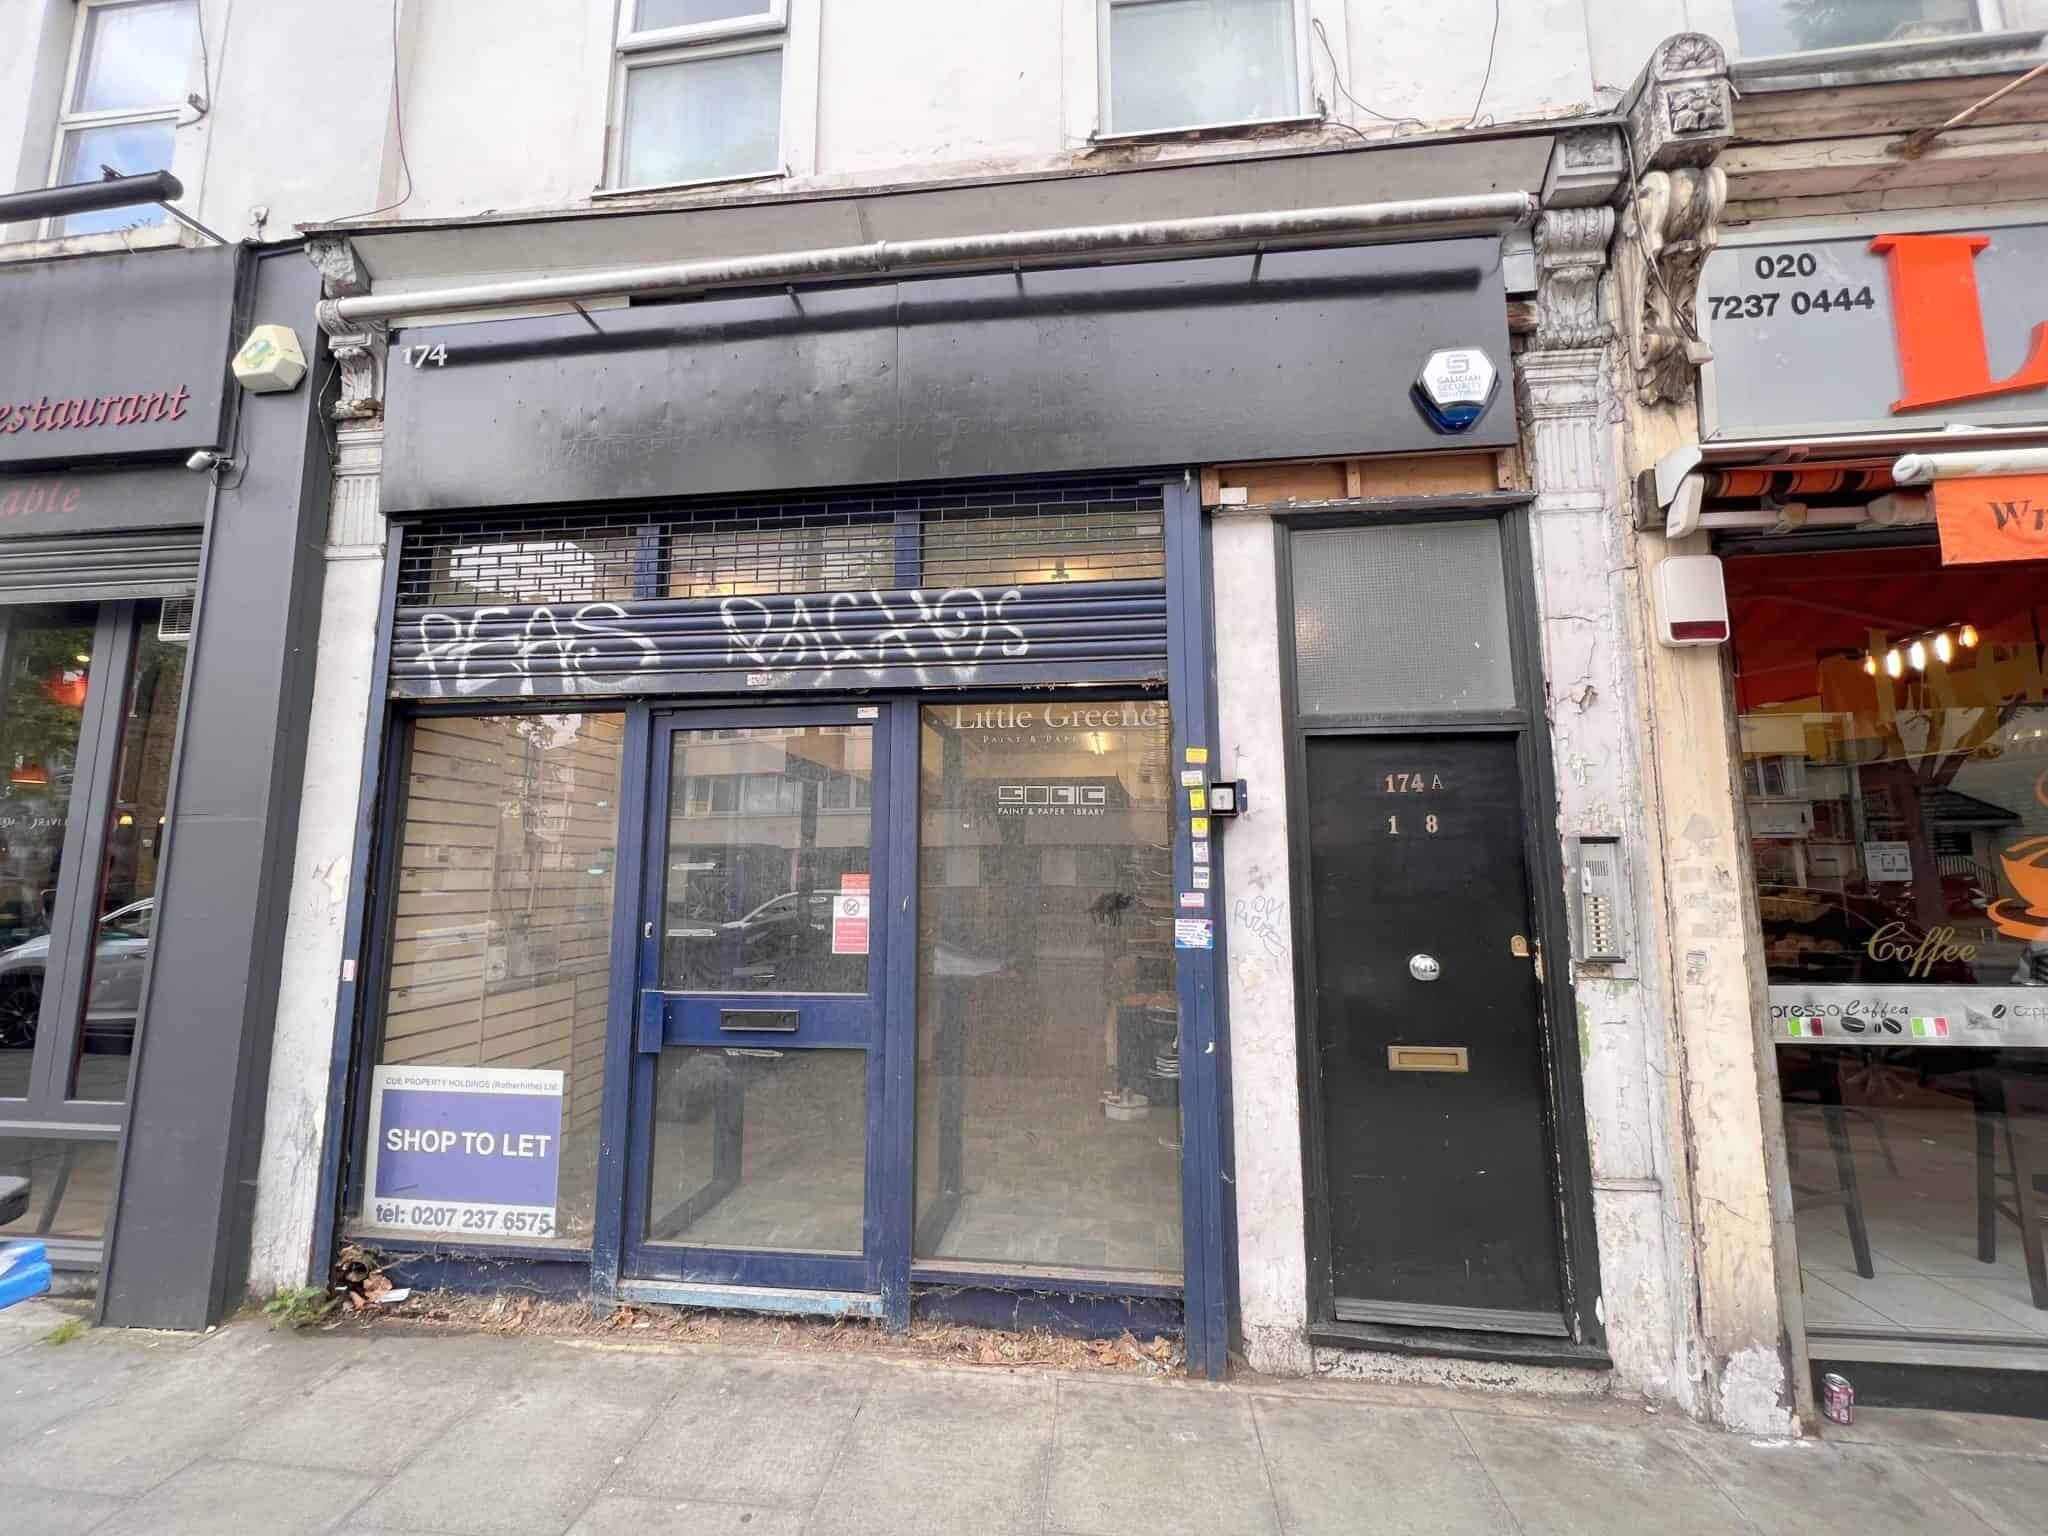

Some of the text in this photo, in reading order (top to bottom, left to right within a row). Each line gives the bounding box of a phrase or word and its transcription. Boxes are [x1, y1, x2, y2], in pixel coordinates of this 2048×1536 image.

[1755, 252, 1817, 280] 020
[1707, 285, 1875, 321] 7237 0444
[399, 343, 448, 369] 174
[952, 701, 1159, 730] Little Greene
[1384, 773, 1445, 793] 174 A
[997, 807, 1025, 816] PAINT
[1037, 807, 1066, 816] PAPER
[1072, 807, 1105, 817] IBRARY
[1388, 814, 1439, 834] 1 8
[1862, 921, 1978, 977] Coffee
[1769, 1004, 1841, 1024] presso
[404, 1078, 446, 1088] PROPERTY
[448, 1079, 490, 1090] HOLDINGS
[386, 1128, 552, 1158] SHOP TO LET
[410, 1206, 458, 1227] 0207
[461, 1209, 499, 1230] 237
[503, 1211, 553, 1236] 6575
